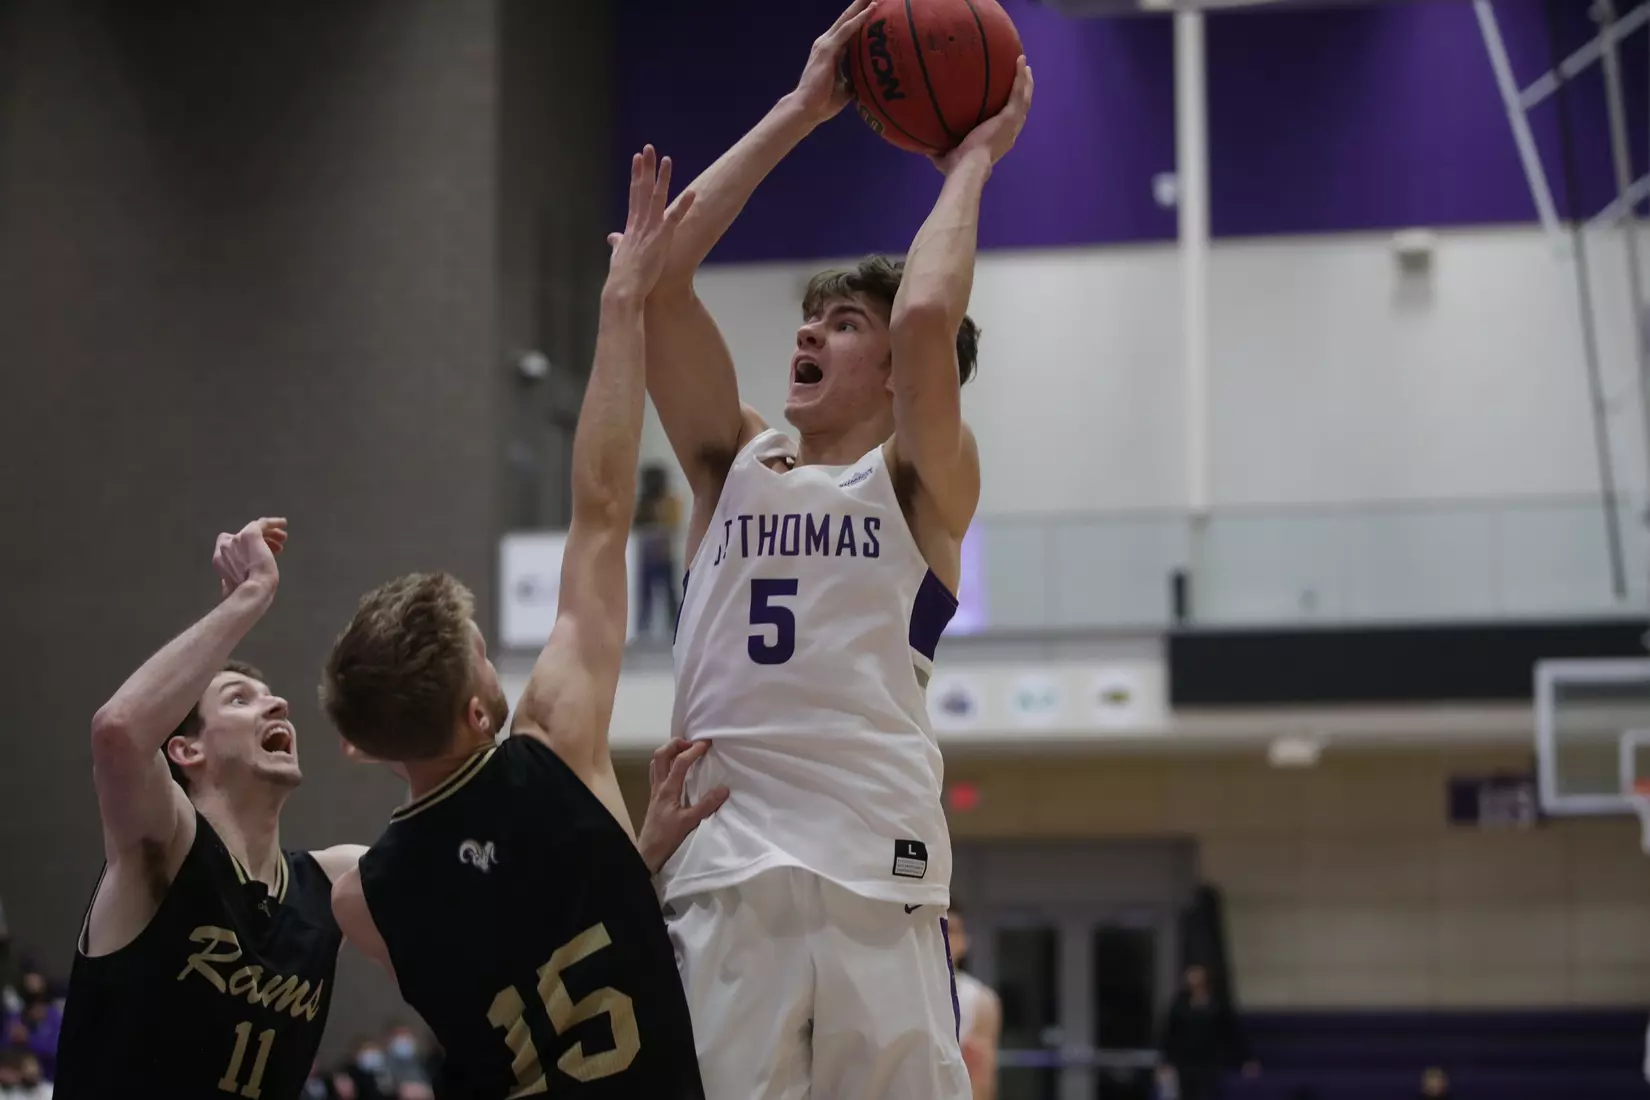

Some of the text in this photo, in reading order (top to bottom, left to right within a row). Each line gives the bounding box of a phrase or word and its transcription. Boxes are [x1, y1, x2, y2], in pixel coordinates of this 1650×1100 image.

[867, 17, 906, 102] NCAA
[737, 512, 881, 559] THOMAS
[747, 578, 799, 665] 5
[908, 843, 917, 856] L
[176, 925, 324, 1023] Rams
[486, 921, 642, 1100] 15
[217, 1020, 276, 1100] 11
